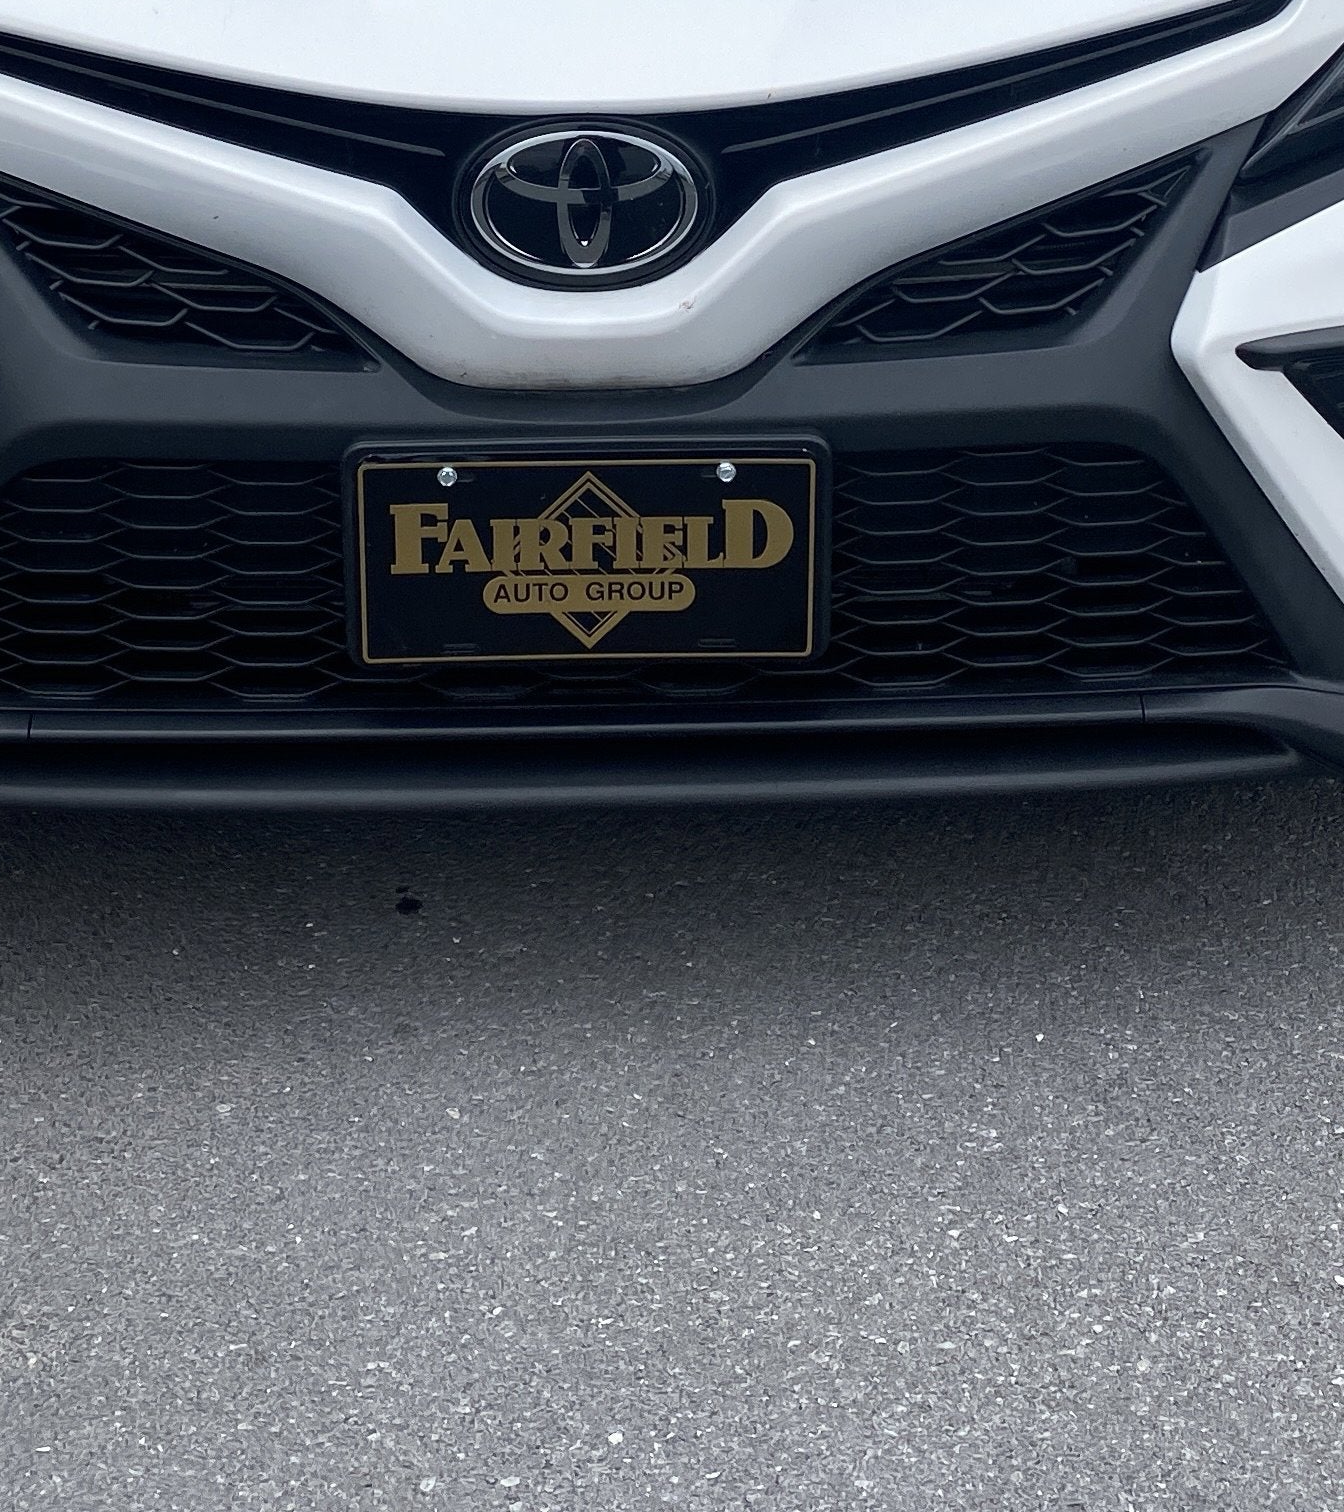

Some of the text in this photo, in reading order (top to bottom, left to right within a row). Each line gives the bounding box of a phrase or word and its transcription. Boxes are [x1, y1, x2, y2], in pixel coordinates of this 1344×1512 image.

[389, 499, 794, 575] FAIRFIELD
[493, 581, 685, 604] AUTO GROUP
